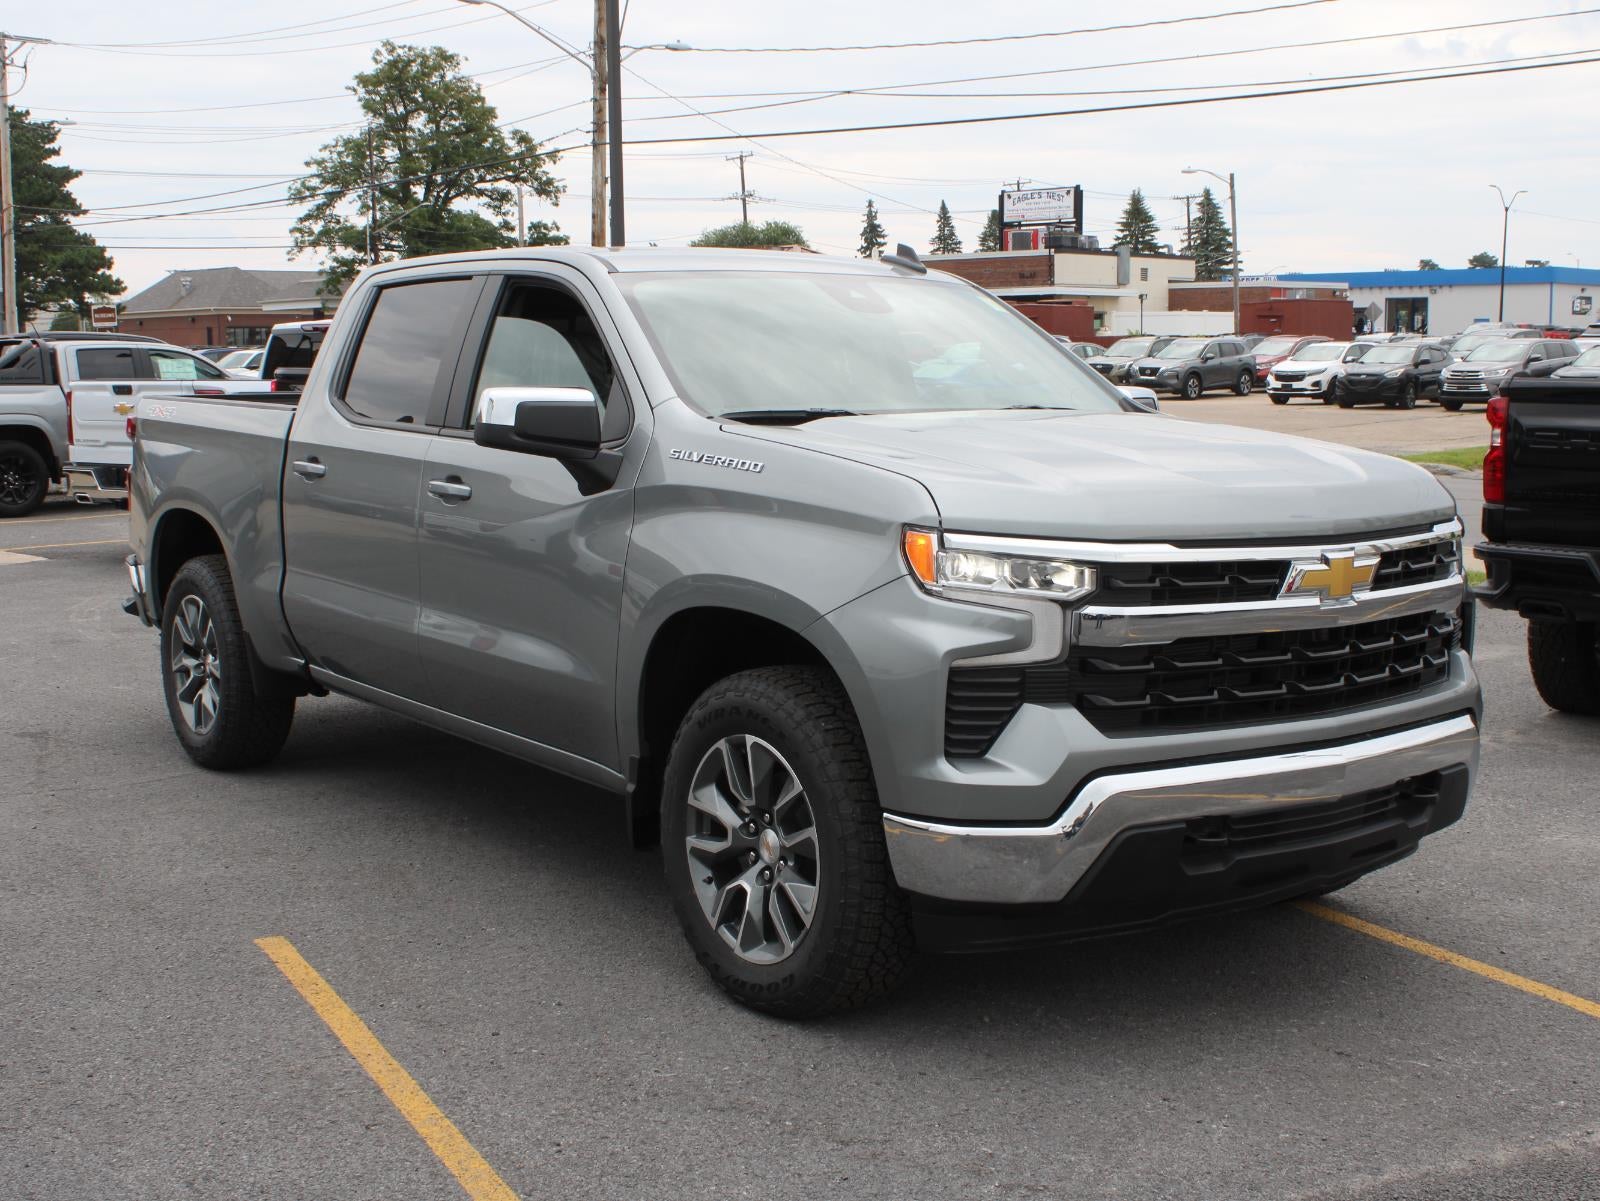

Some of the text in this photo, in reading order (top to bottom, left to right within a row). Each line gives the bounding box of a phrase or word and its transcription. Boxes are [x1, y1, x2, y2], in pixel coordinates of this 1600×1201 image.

[1012, 191, 1065, 206] EAGLE'S NEST
[669, 448, 765, 474] SILVERADO
